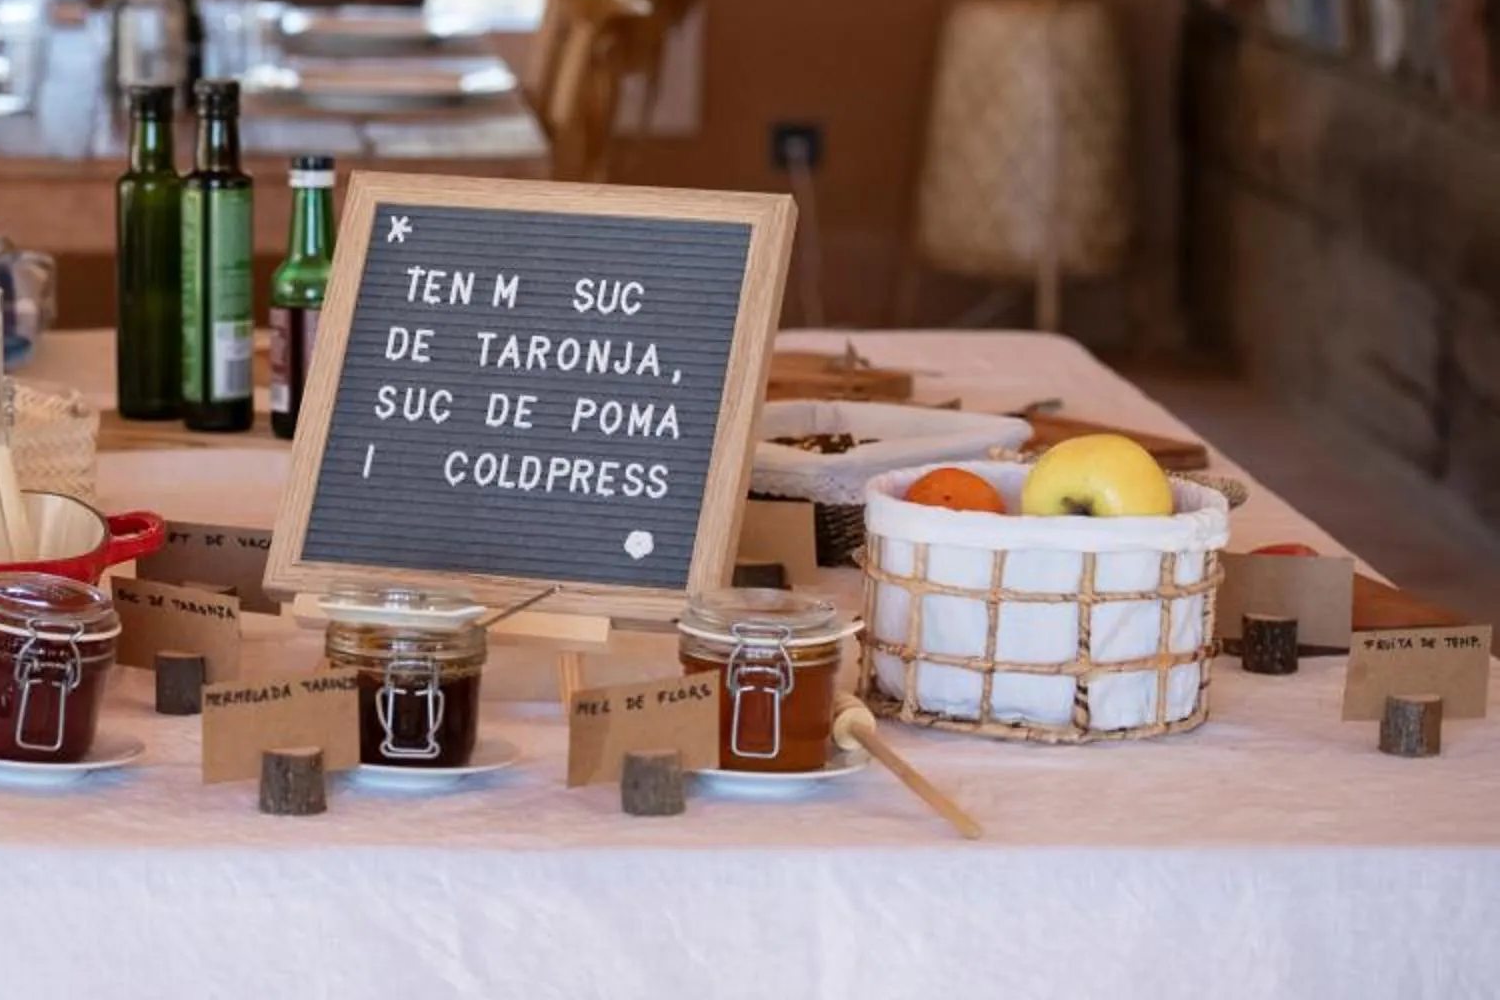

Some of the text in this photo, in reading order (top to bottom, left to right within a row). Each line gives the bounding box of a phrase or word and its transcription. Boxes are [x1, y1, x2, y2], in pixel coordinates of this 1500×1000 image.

[572, 277, 644, 315] SUC
[385, 326, 682, 385] DE TARONJA,
[374, 385, 680, 440] SUC DE POMA
[362, 443, 669, 499] I COLDPRESS
